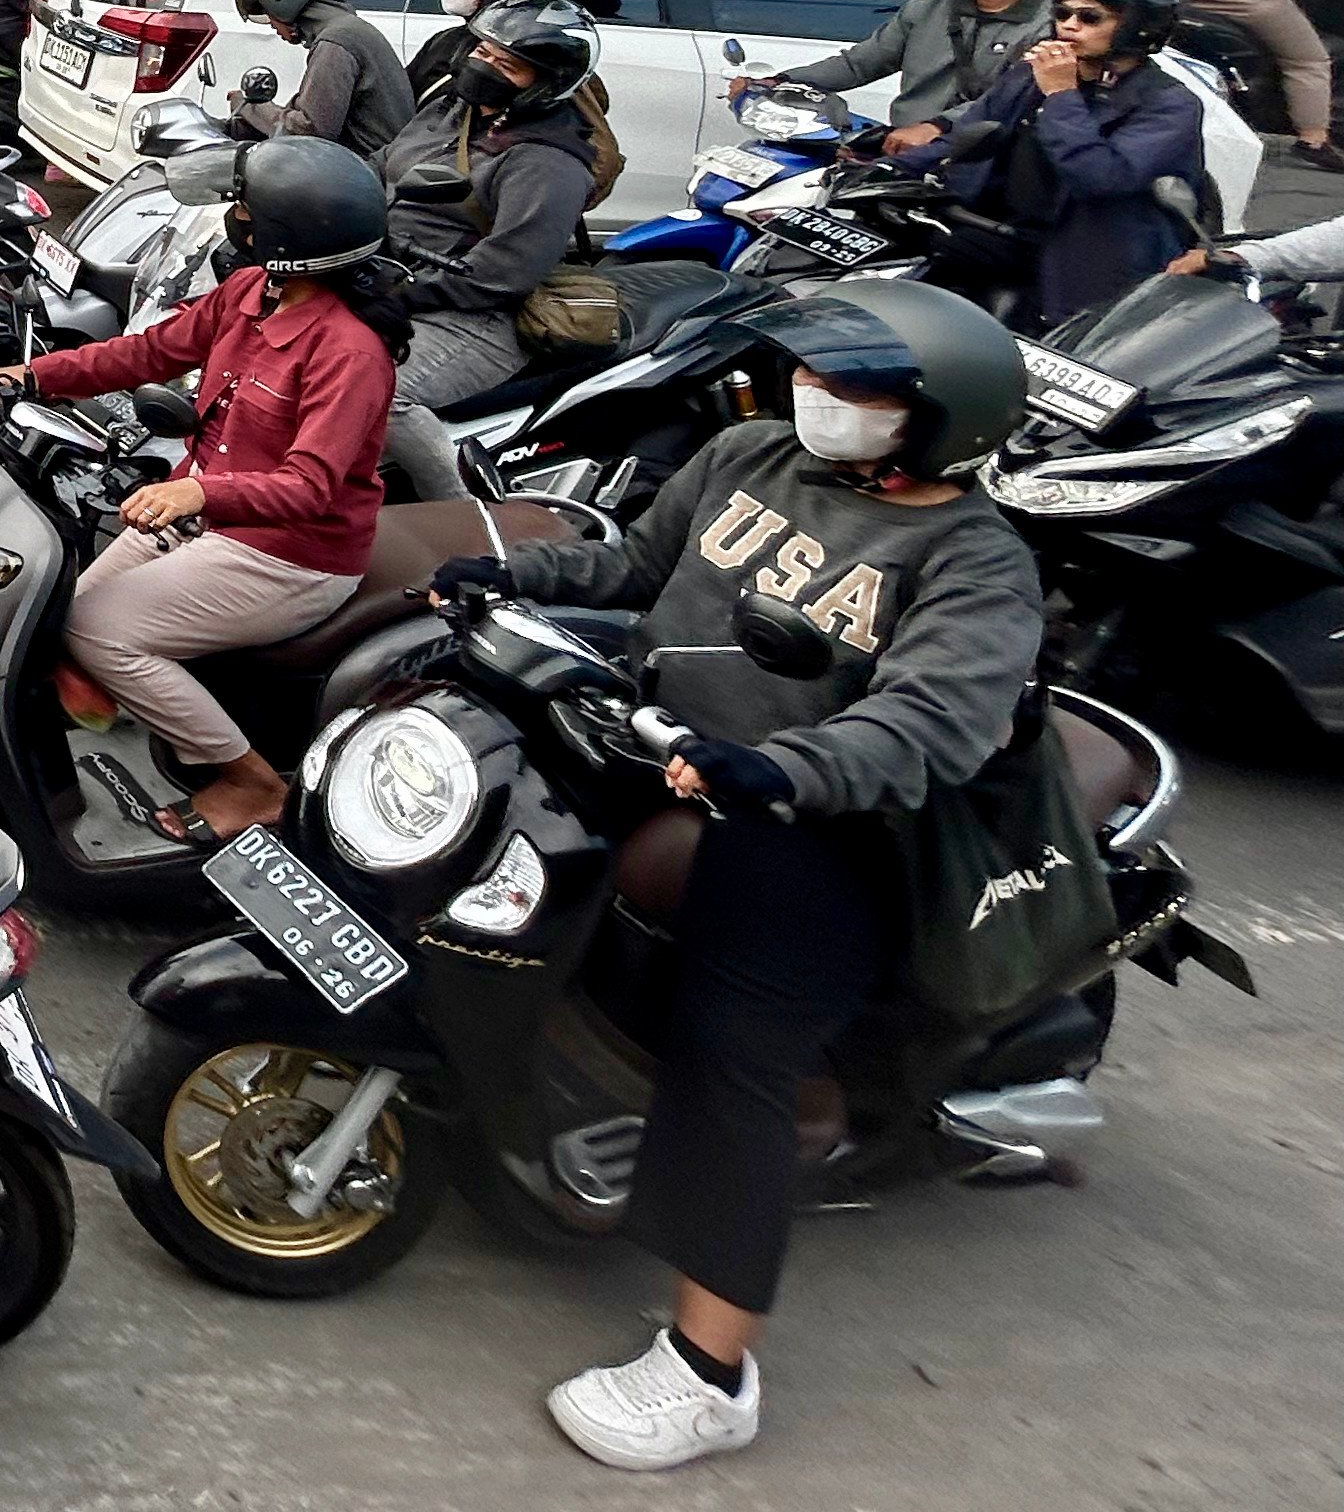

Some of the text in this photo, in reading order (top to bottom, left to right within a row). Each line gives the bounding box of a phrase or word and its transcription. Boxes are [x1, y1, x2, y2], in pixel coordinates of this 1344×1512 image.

[266, 260, 305, 272] ARC
[700, 490, 883, 654] USA
[235, 832, 282, 871] DK
[331, 923, 395, 981] CBD
